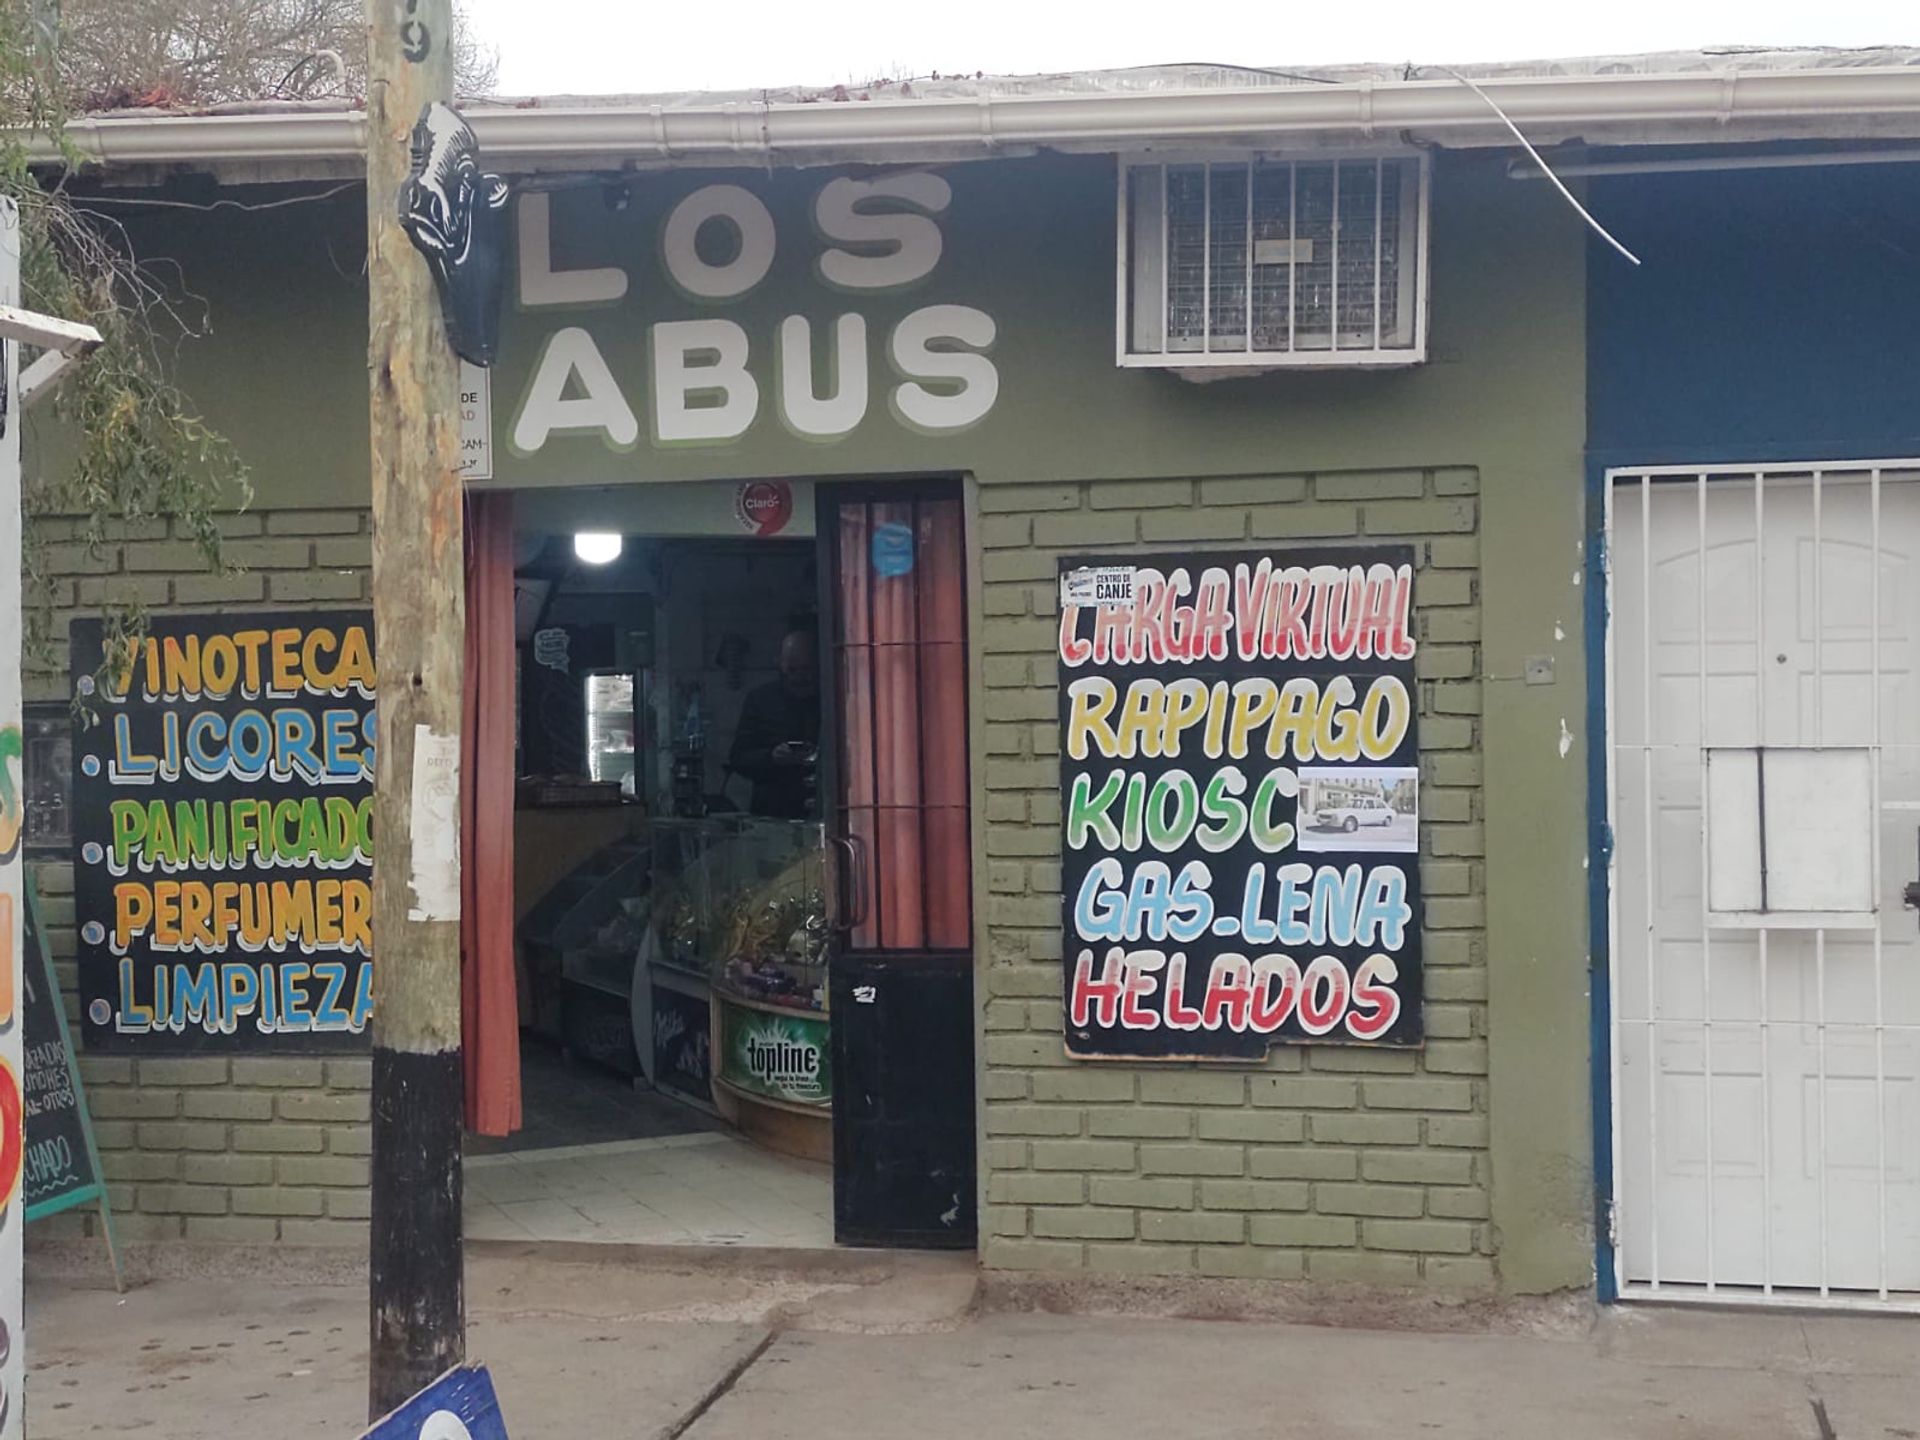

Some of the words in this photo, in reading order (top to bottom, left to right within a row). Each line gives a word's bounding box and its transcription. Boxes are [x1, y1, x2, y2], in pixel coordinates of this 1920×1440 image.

[518, 172, 952, 306] LOS
[513, 304, 1000, 452] ABUS
[745, 499, 775, 509] Claro
[1096, 584, 1132, 599] CANJE
[1234, 557, 1416, 664] VIRTUAL
[102, 626, 376, 703] VINOTECA
[1066, 675, 1410, 761] RAPIPAGO
[1070, 946, 1400, 1041] HELADOS
[747, 1038, 817, 1081] topline
